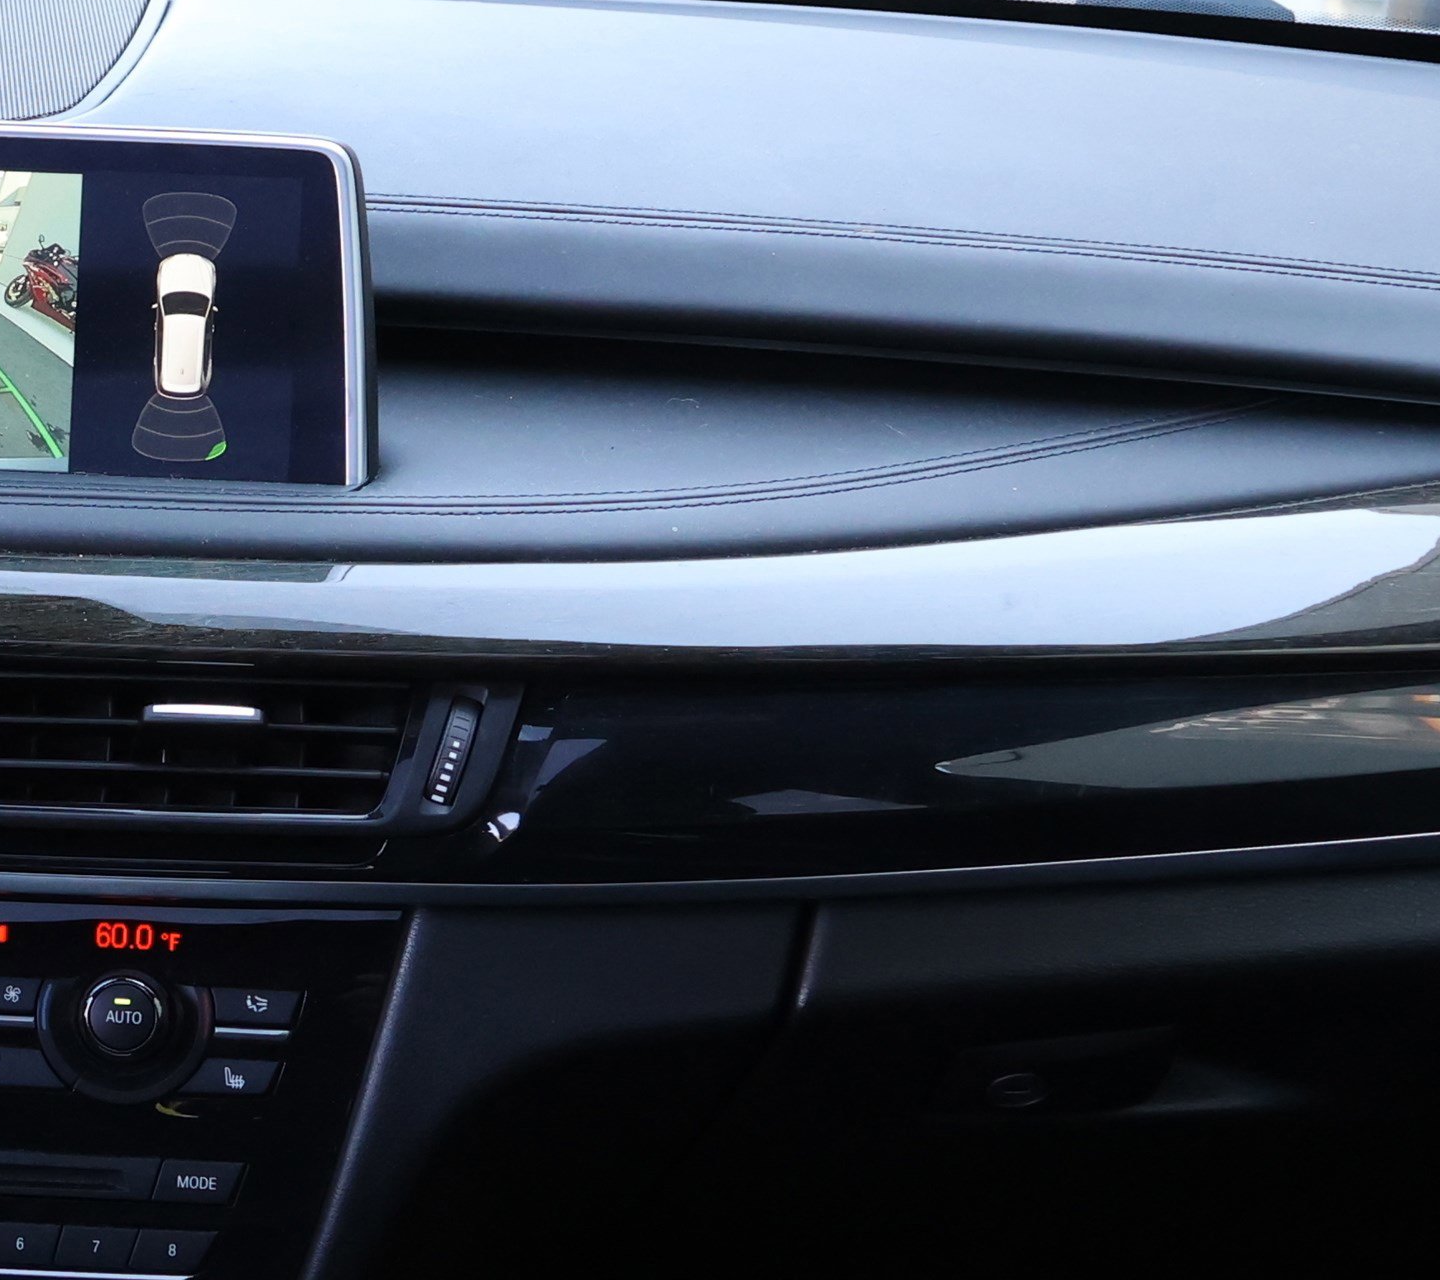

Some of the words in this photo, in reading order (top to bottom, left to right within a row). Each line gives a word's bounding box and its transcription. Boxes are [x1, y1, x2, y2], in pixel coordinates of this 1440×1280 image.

[95, 921, 154, 951] 60.0
[105, 1009, 143, 1025] AUTO
[176, 1175, 218, 1191] MODE
[16, 1237, 24, 1251] 6
[92, 1240, 101, 1254] 7
[168, 1243, 177, 1257] 8
